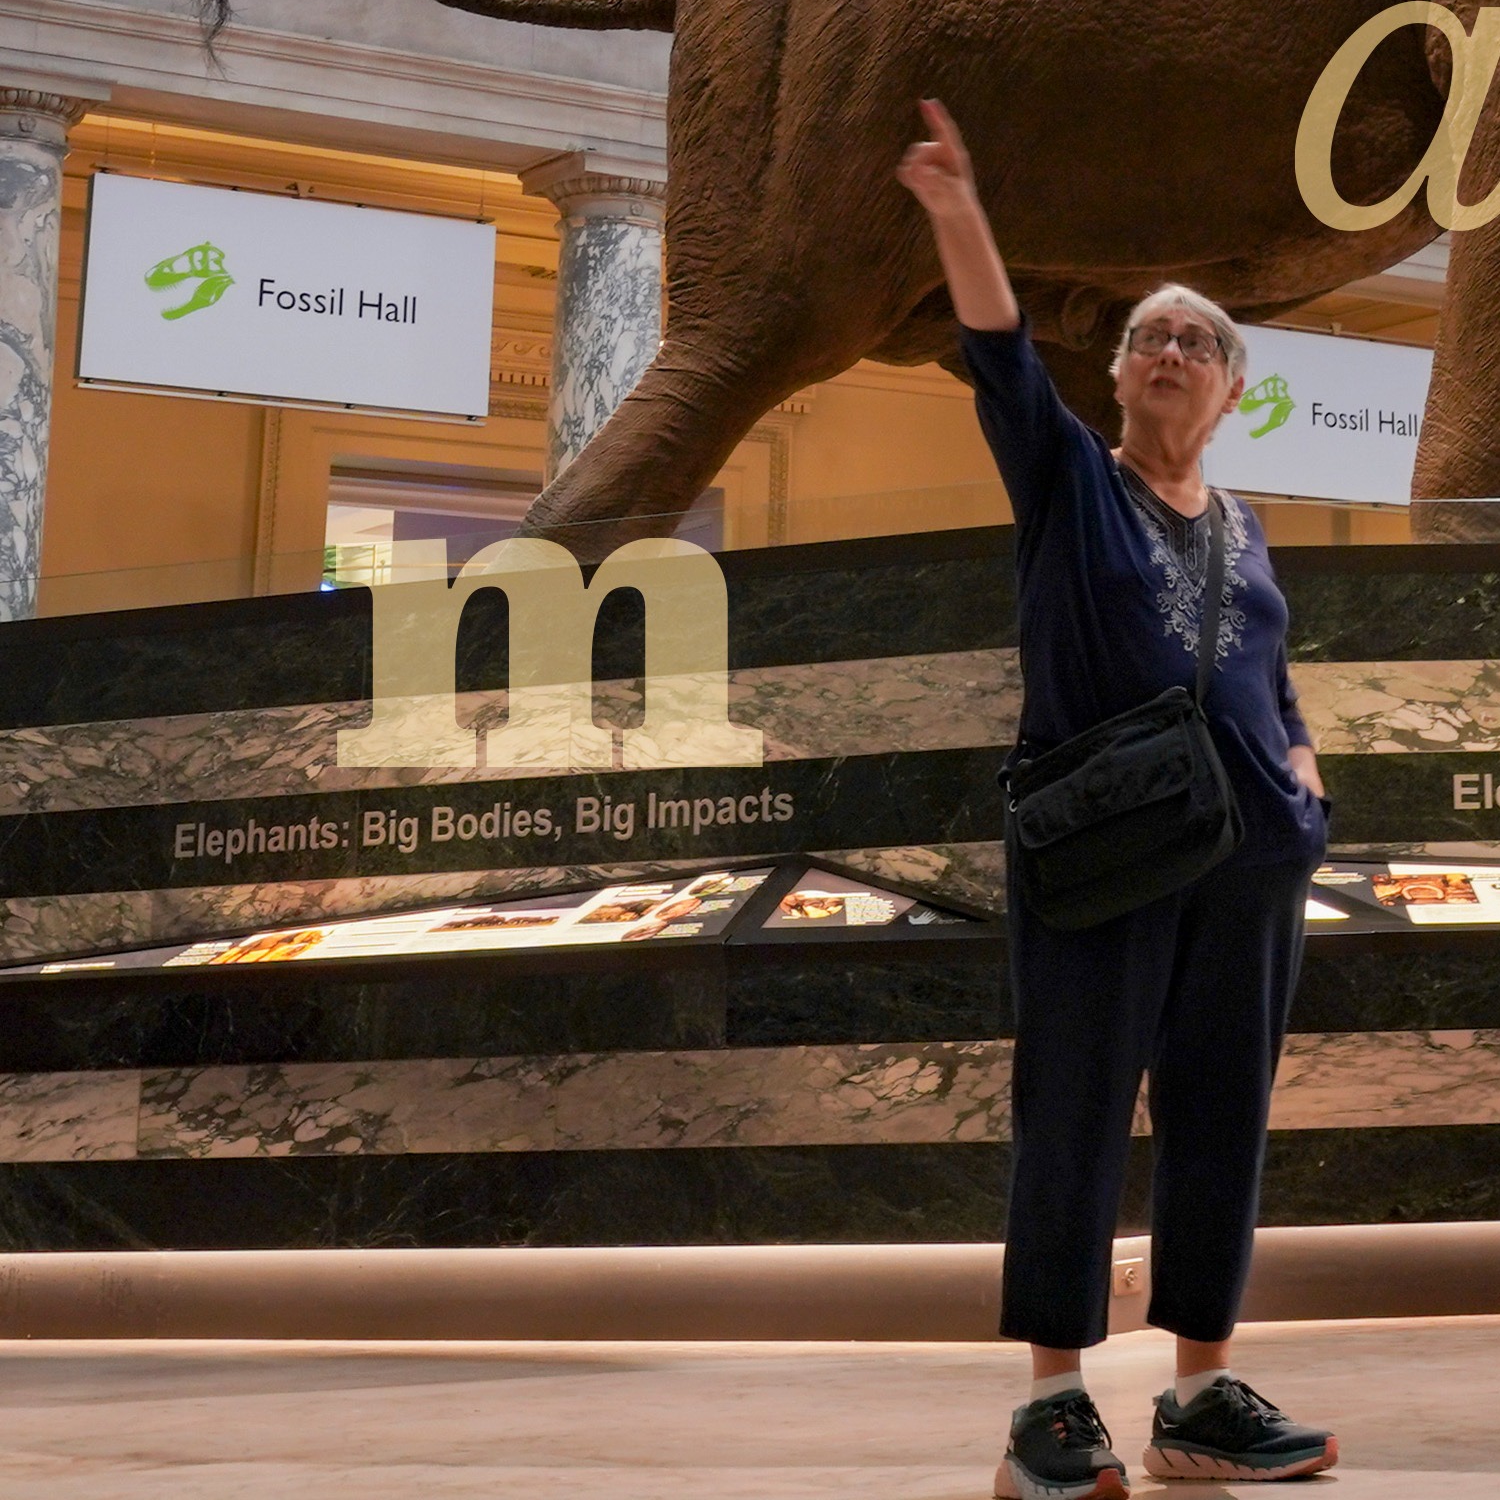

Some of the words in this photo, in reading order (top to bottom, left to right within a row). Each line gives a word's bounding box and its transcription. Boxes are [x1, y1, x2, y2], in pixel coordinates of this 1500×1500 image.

[258, 278, 345, 316] Fossil
[358, 288, 417, 326] Hall
[1311, 402, 1369, 432] Fossil
[1378, 410, 1418, 437] Hall
[173, 815, 351, 864] Elephants:
[361, 812, 418, 854] Big
[430, 800, 563, 843] Bodies,
[576, 795, 636, 840] Big
[646, 786, 795, 828] Impacts
